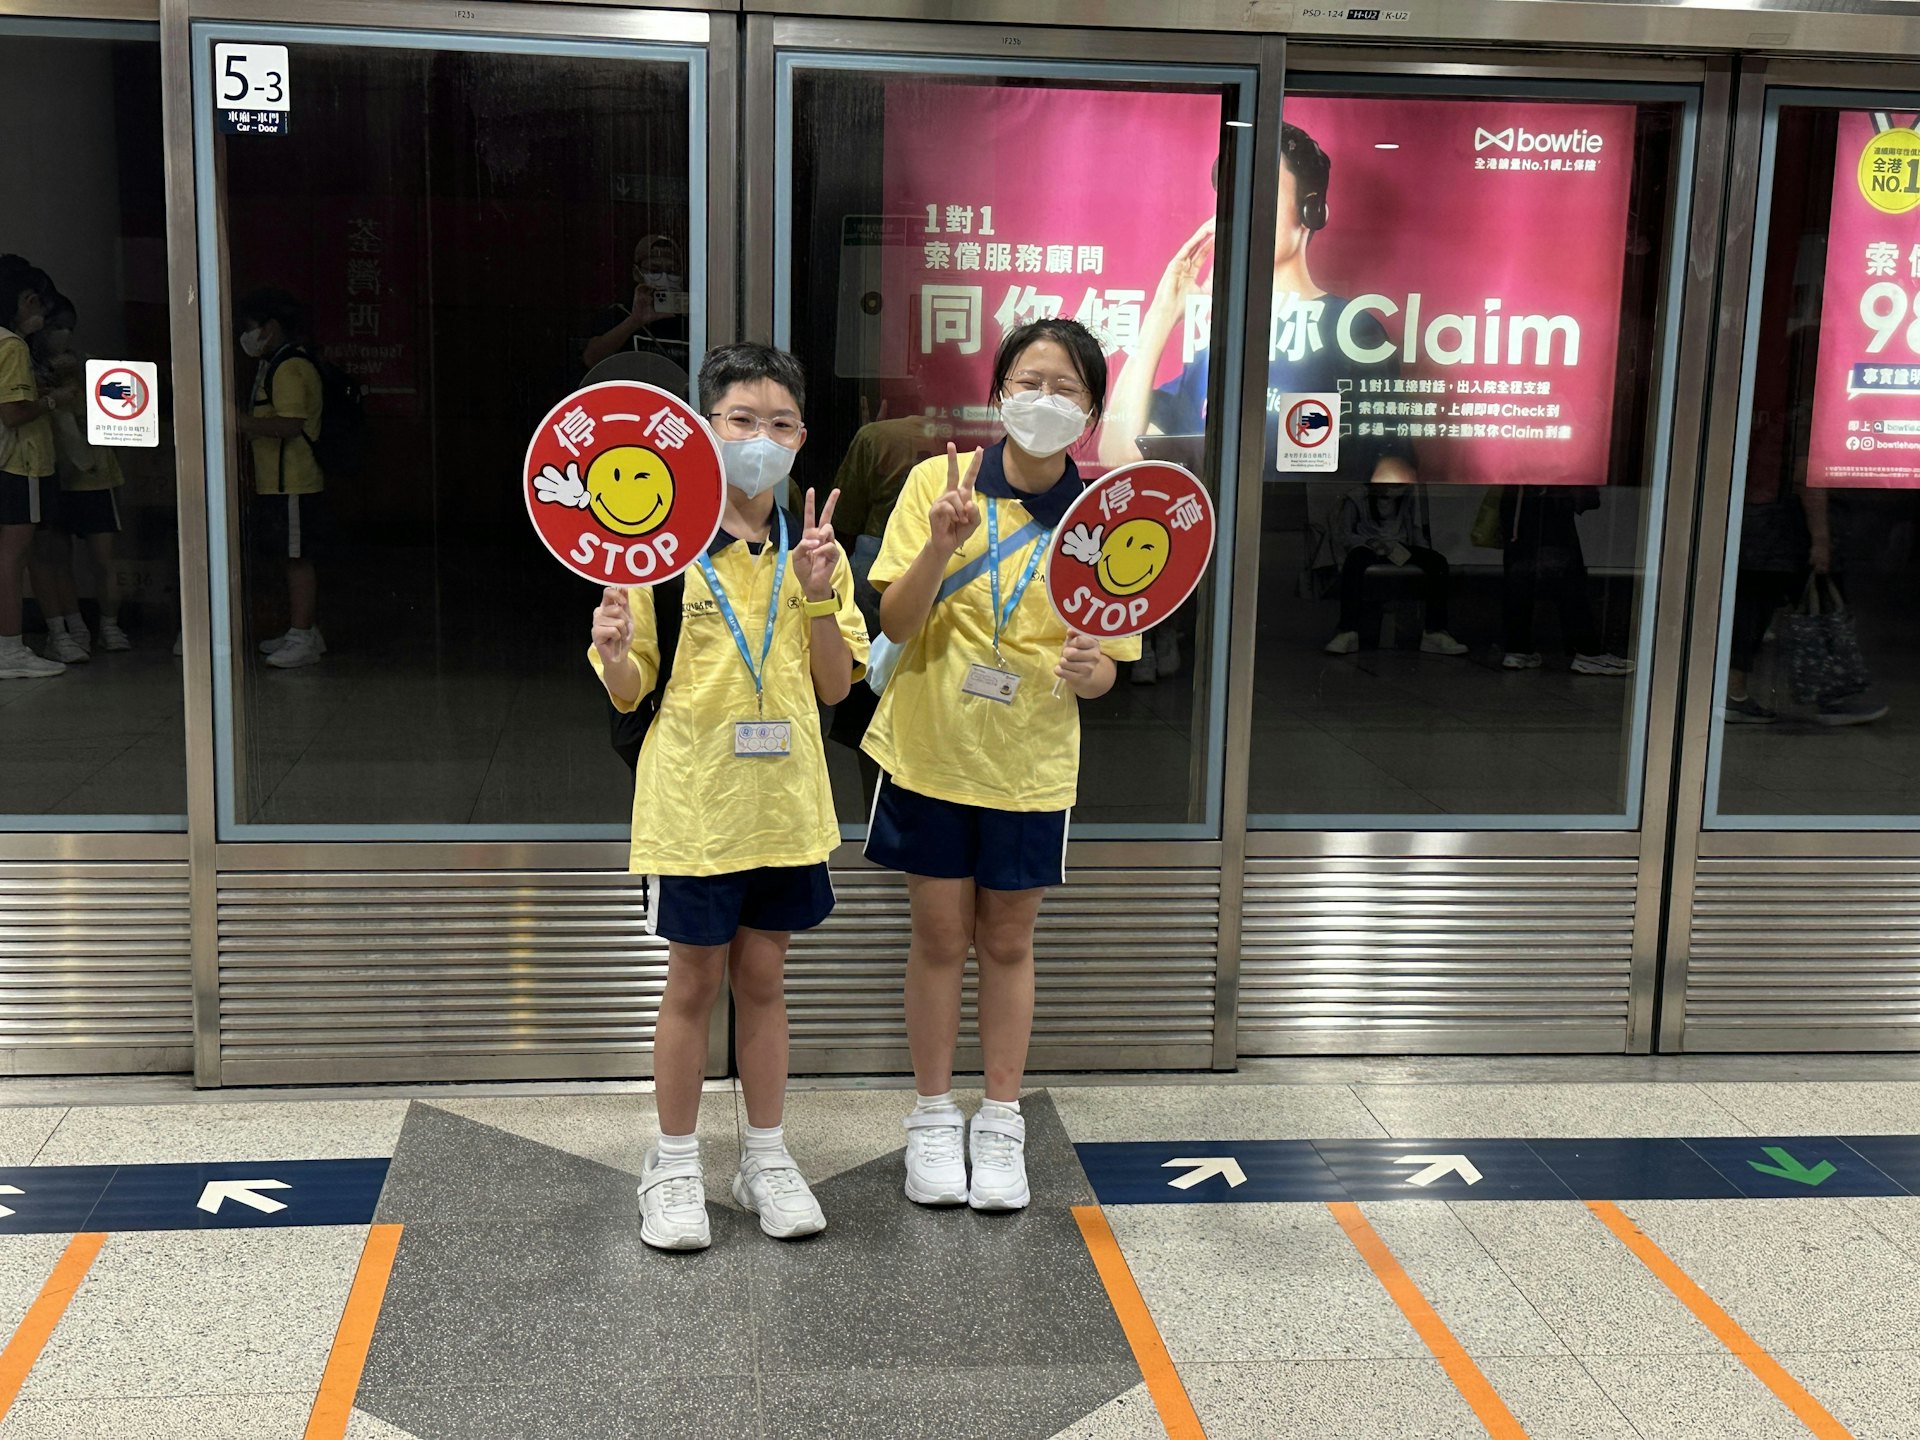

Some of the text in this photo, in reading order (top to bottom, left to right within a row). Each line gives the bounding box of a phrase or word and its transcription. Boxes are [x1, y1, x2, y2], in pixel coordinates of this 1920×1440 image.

[236, 123, 251, 132] Car
[257, 123, 278, 133] Door
[1516, 127, 1604, 154] bowtie
[1872, 157, 1903, 174] 全港
[923, 240, 1104, 275] 索償服務顧問
[553, 405, 694, 458] 停一停
[1099, 477, 1204, 531] 停一停
[569, 532, 679, 577] STOP
[1063, 586, 1149, 631] STOP
